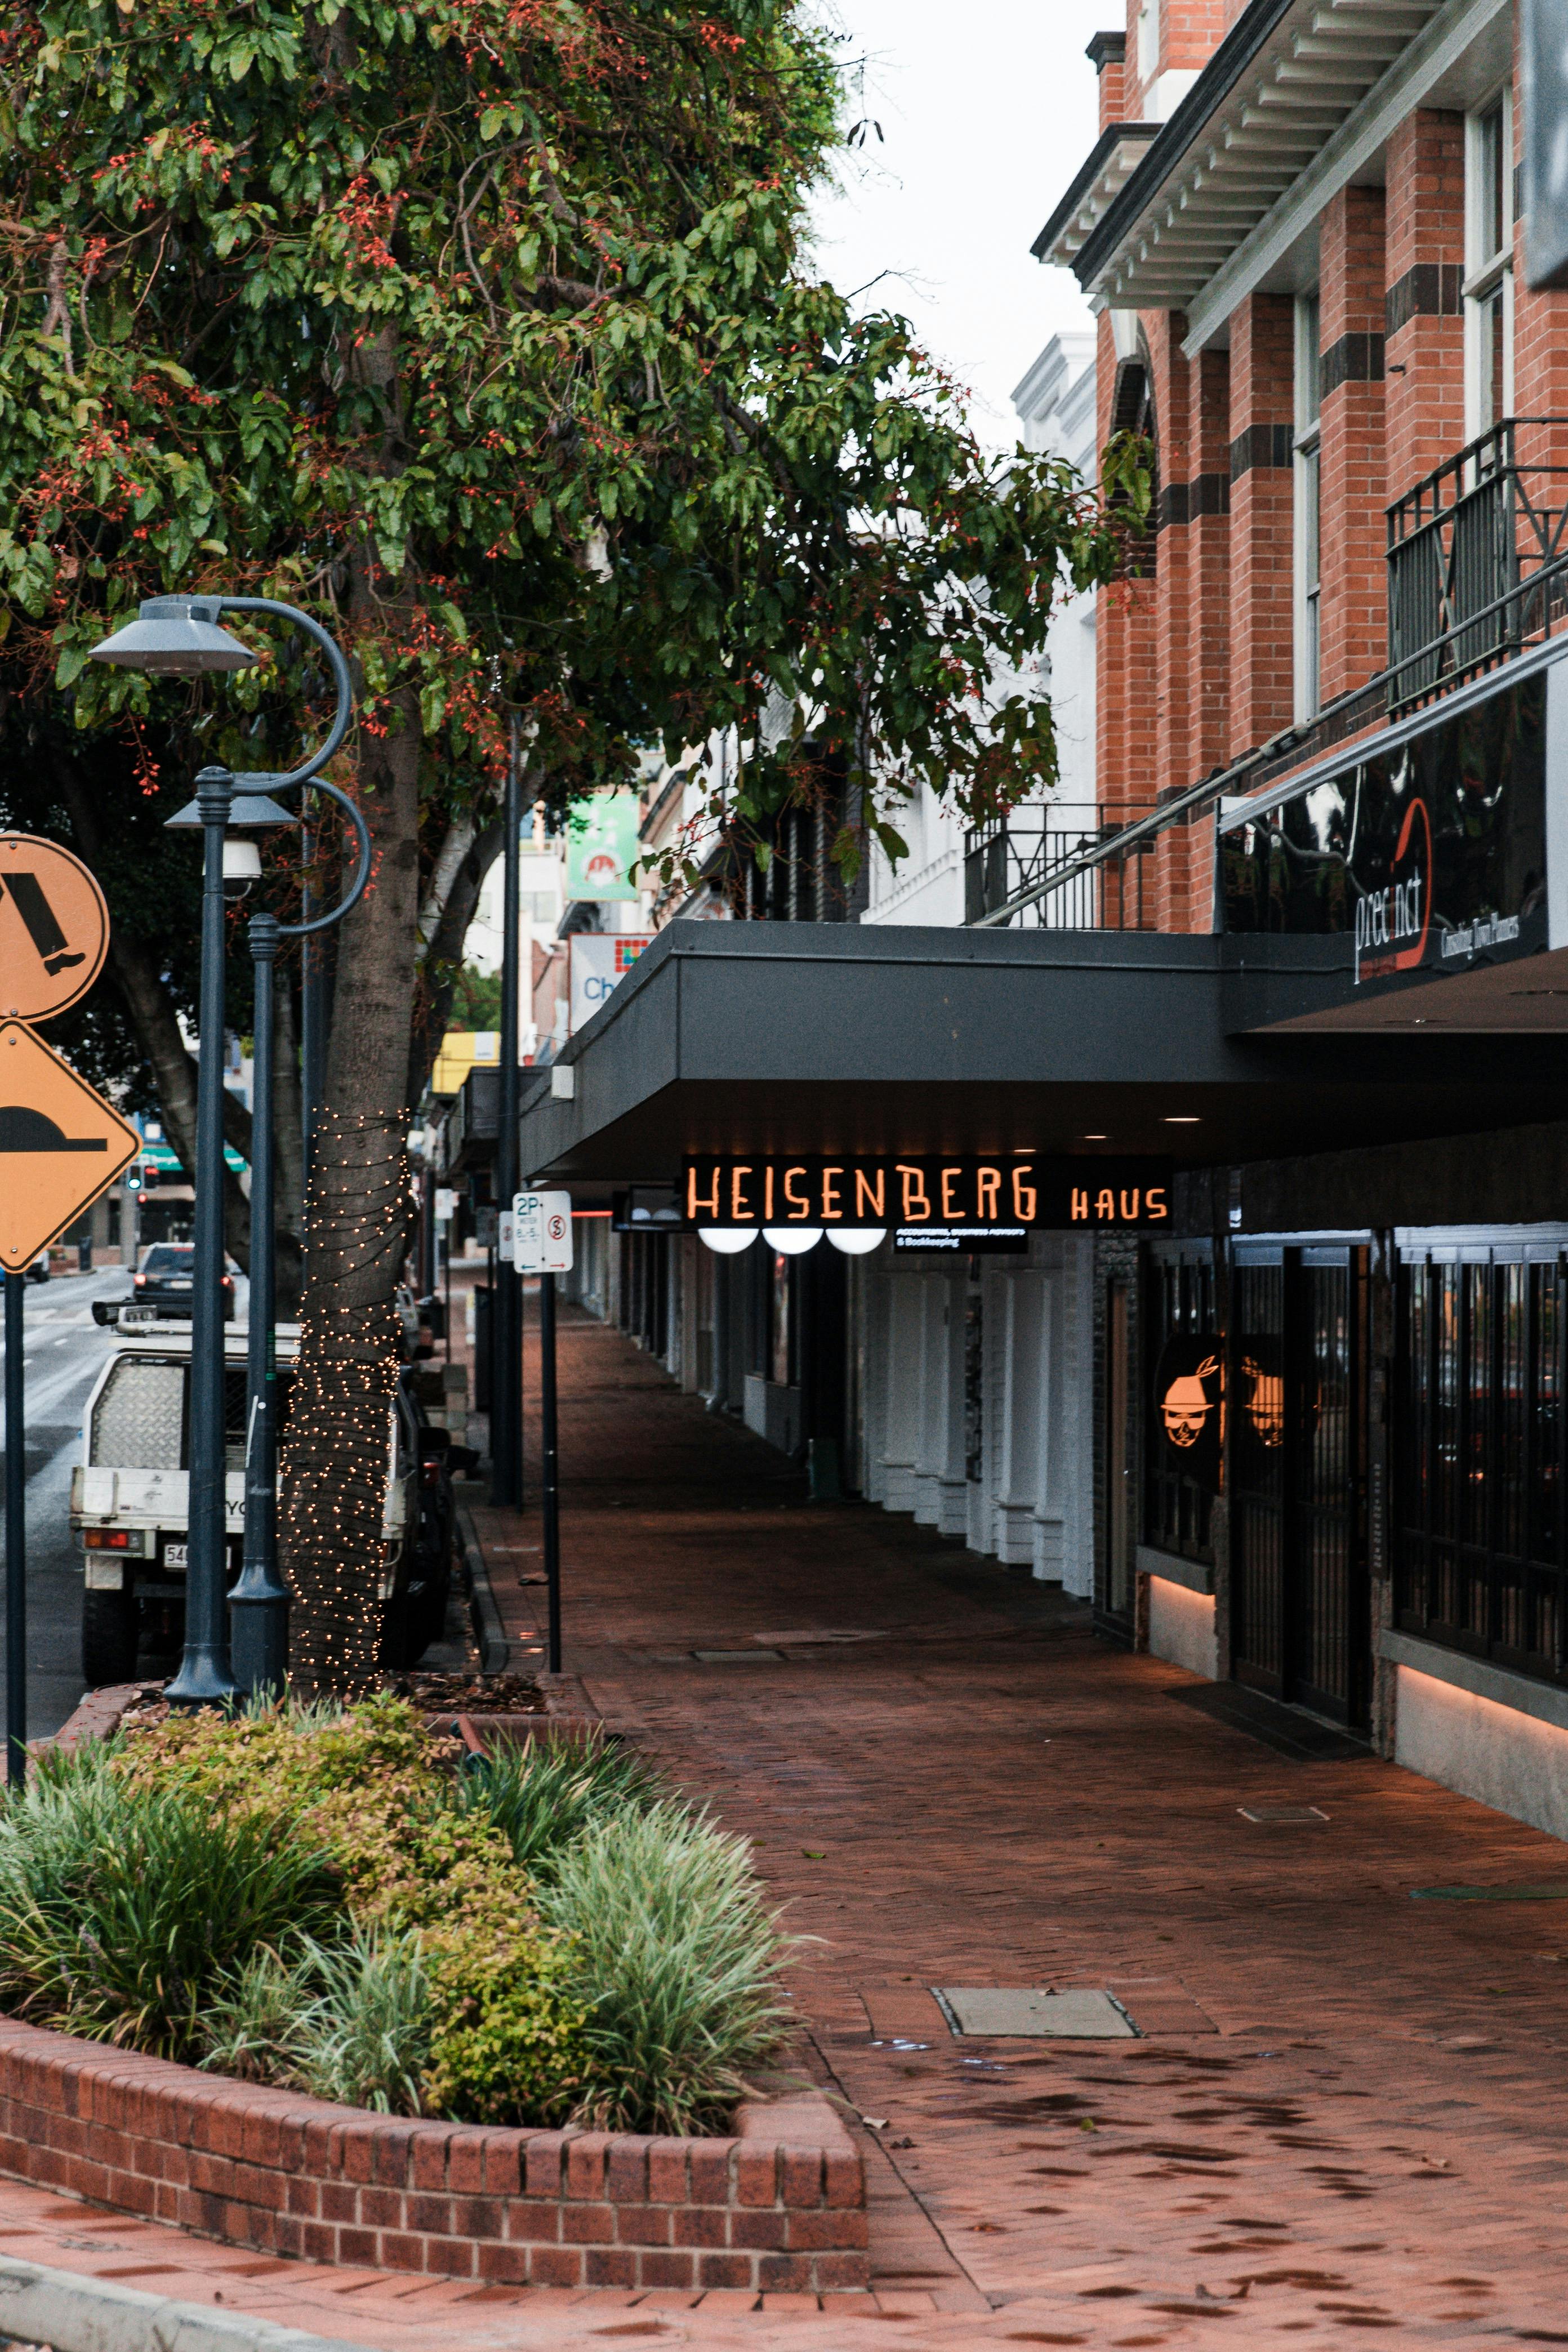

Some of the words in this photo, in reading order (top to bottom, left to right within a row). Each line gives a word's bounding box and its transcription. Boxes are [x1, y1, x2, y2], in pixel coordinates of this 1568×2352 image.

[1354, 862, 1422, 985] precinct
[517, 1197, 538, 1215] 2P
[687, 1166, 1037, 1220] HEISENBERG
[1071, 1188, 1168, 1220] HAUS
